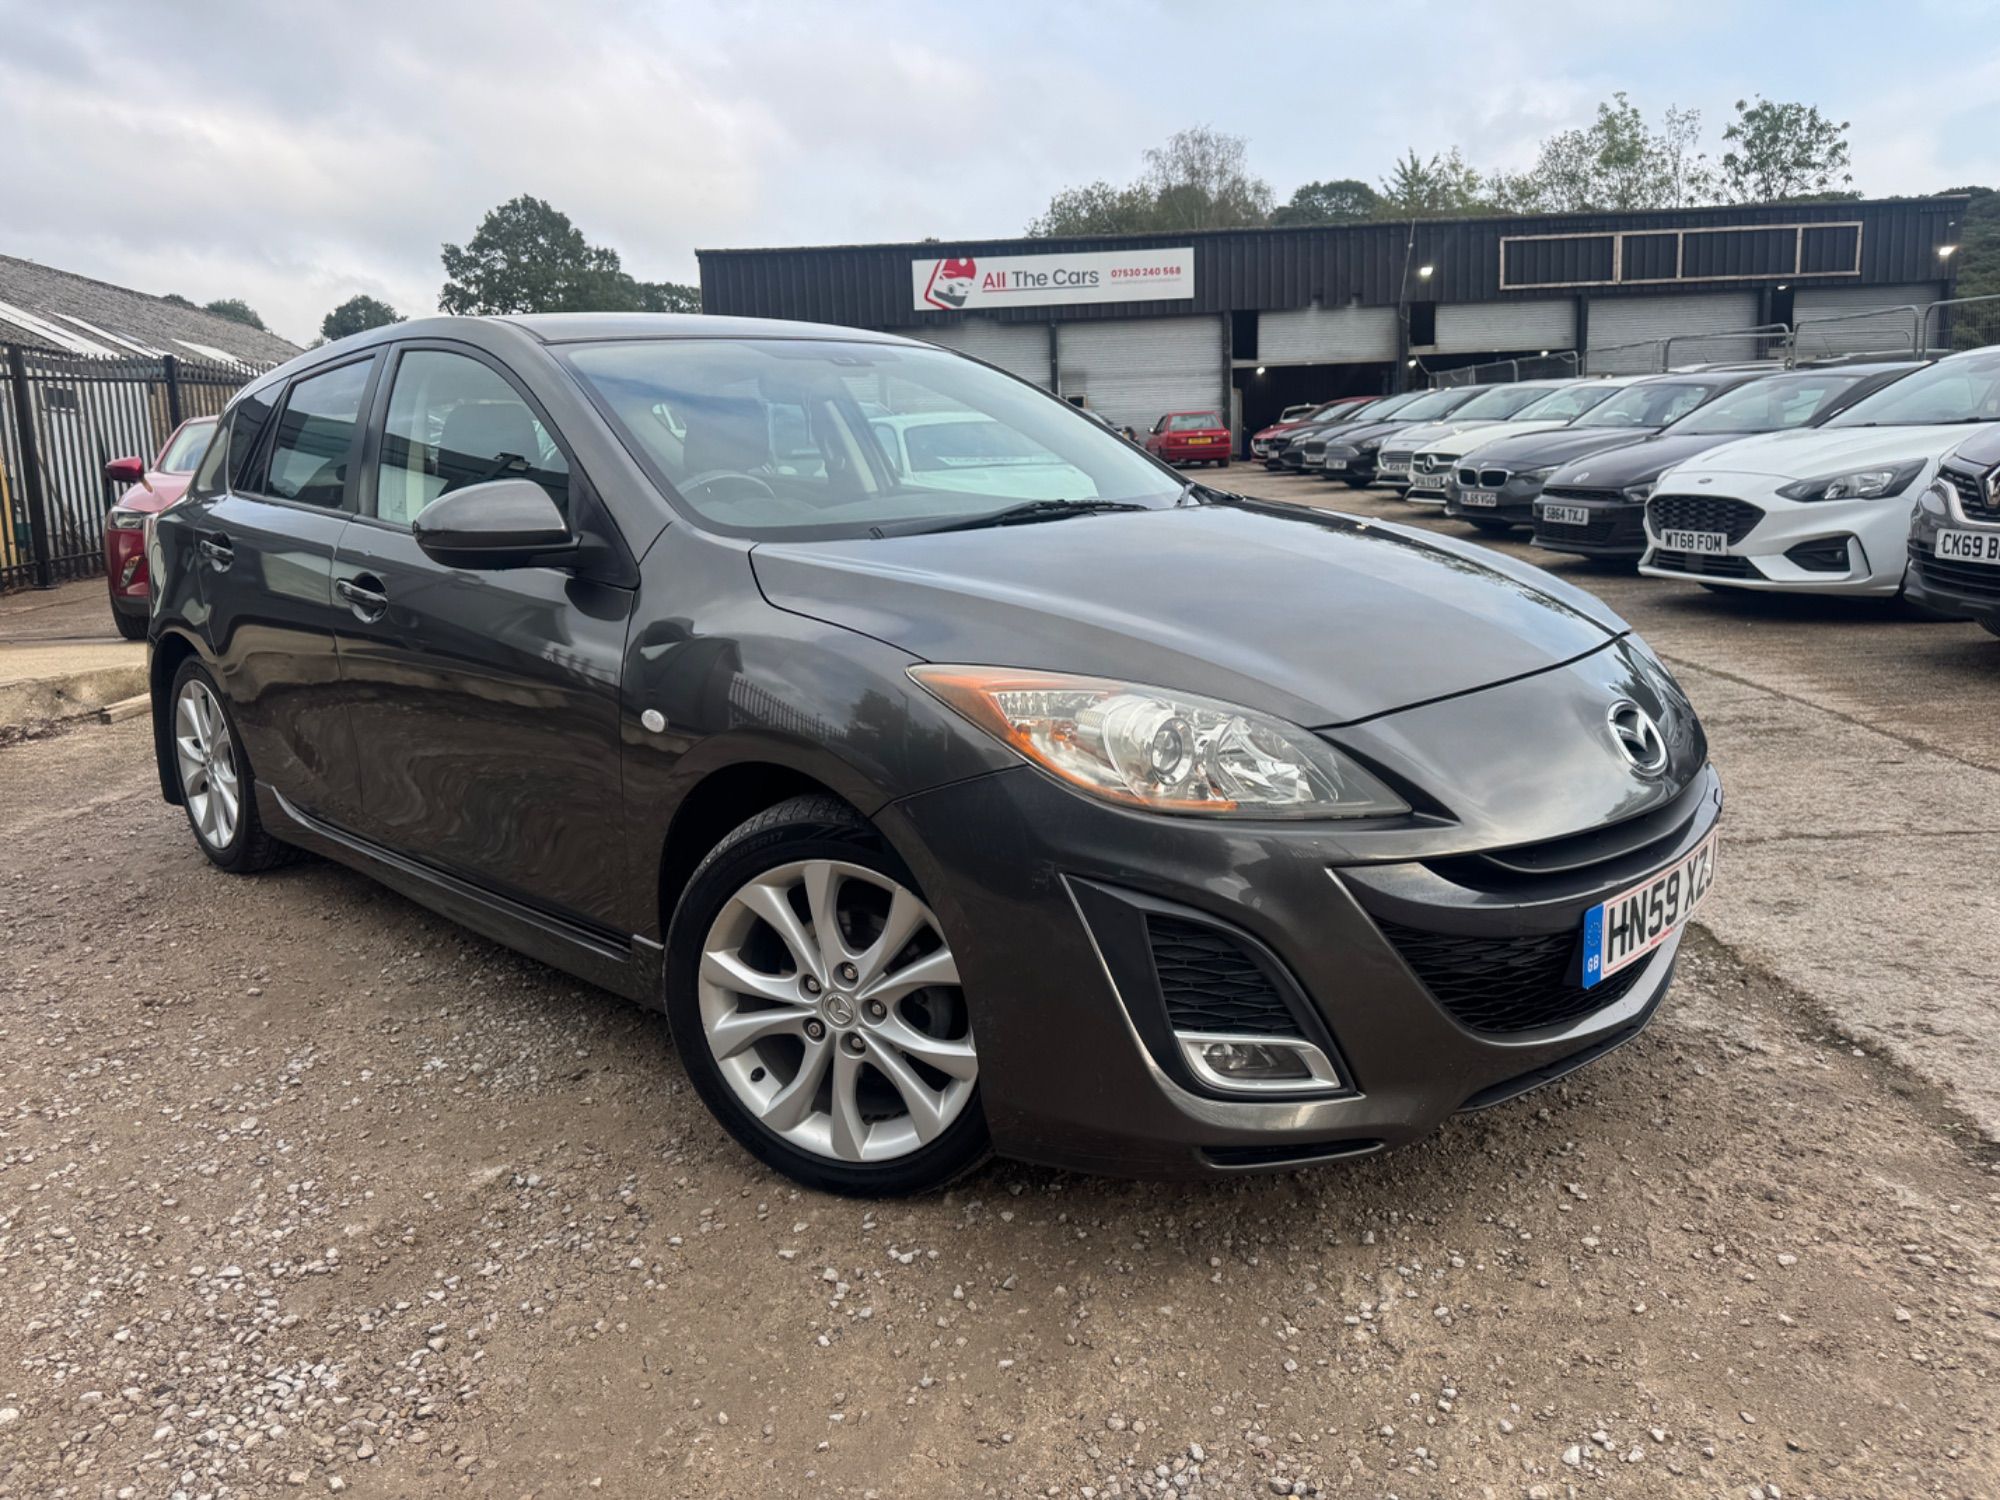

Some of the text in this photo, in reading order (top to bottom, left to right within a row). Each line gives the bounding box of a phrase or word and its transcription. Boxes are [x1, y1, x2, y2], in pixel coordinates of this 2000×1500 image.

[982, 269, 1099, 288] All The Cars
[1111, 268, 1141, 278] 07530
[1142, 267, 1161, 276] 240
[1665, 531, 1722, 552] WT68 FOM
[1942, 533, 1983, 557] CK69
[1607, 869, 1680, 964] HN59
[1587, 954, 1599, 973] GB
